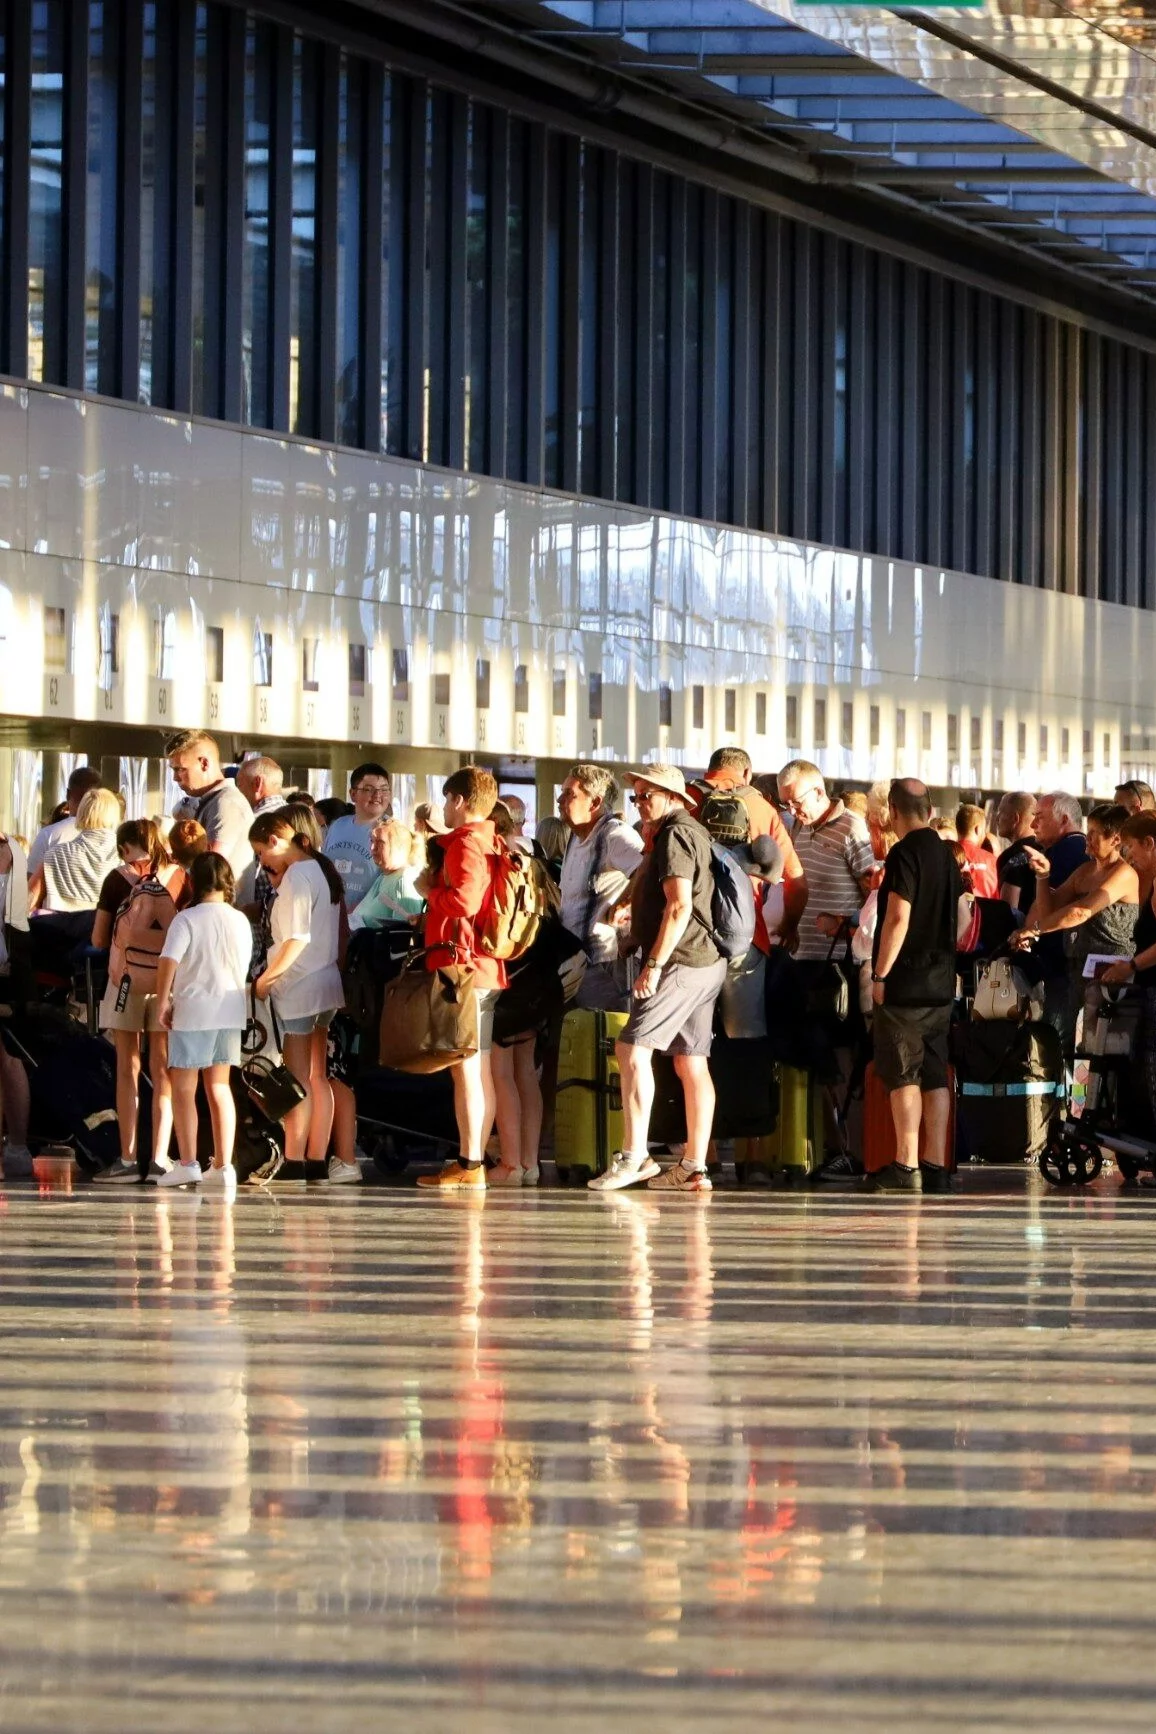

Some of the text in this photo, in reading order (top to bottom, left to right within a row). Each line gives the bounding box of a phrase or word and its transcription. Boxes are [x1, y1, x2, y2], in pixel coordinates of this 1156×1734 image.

[49, 677, 58, 706] 62
[158, 688, 167, 714] 60
[210, 693, 219, 719] 59
